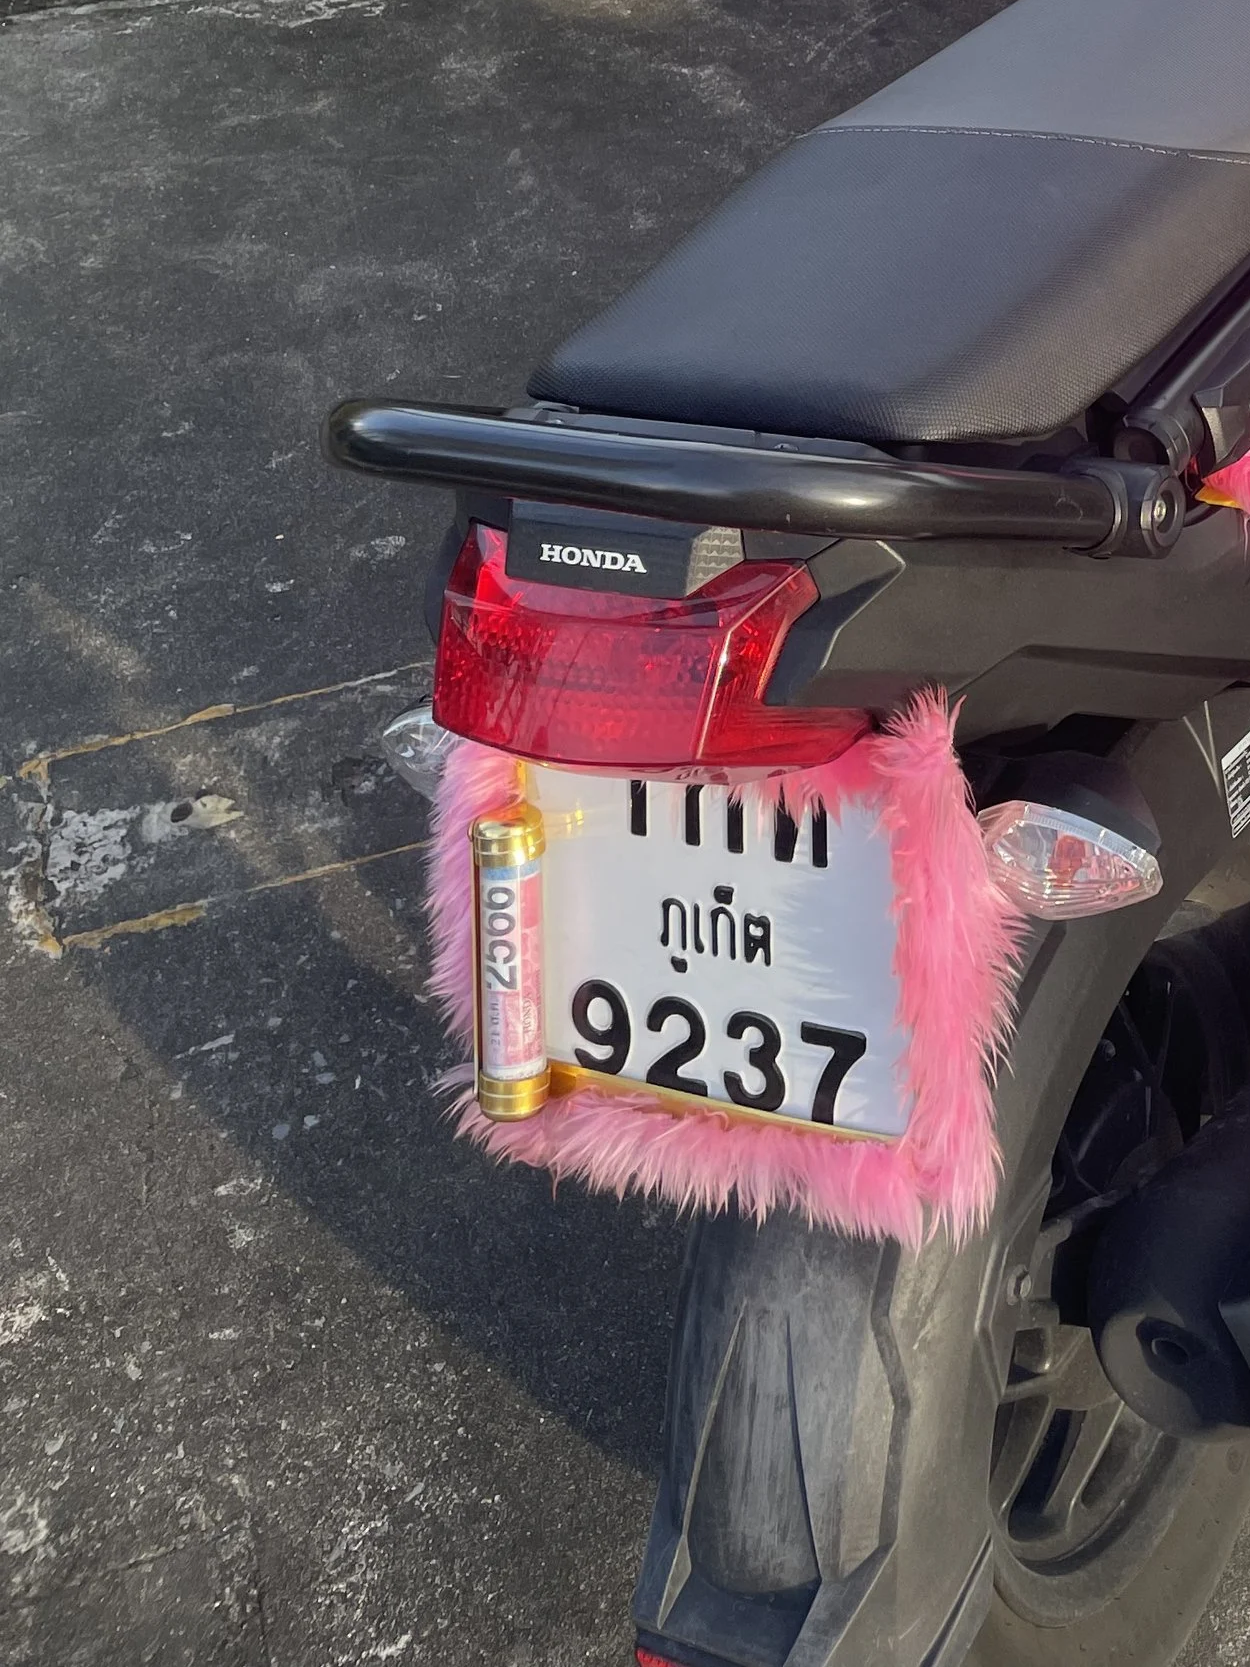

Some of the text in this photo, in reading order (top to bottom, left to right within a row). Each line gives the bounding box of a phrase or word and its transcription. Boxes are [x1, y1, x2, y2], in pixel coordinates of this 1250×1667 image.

[539, 543, 648, 574] HONDA
[484, 885, 518, 992] 2566
[659, 884, 772, 974] ภูเก็ต
[571, 978, 868, 1126] 9237
